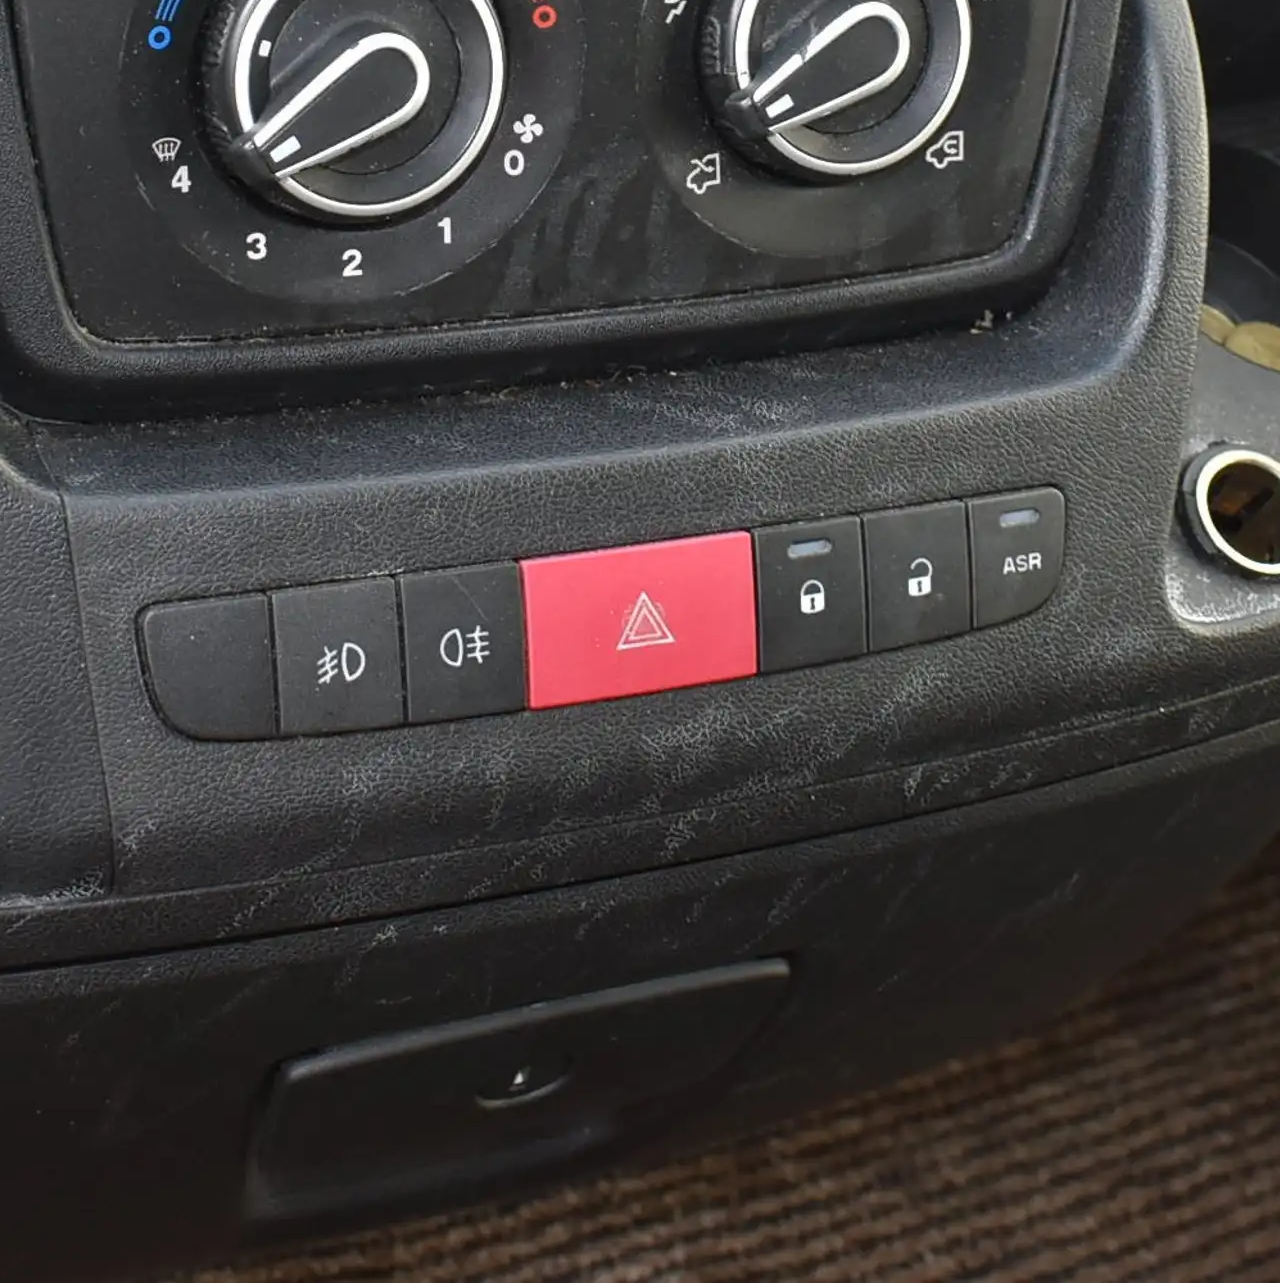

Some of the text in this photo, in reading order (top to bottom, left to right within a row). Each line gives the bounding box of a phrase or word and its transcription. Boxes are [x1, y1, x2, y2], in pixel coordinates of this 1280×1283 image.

[502, 148, 526, 177] 0
[170, 164, 193, 194] 4
[436, 215, 453, 245] 1
[245, 231, 269, 261] 3
[341, 247, 364, 278] 2
[1001, 551, 1043, 576] ASR
